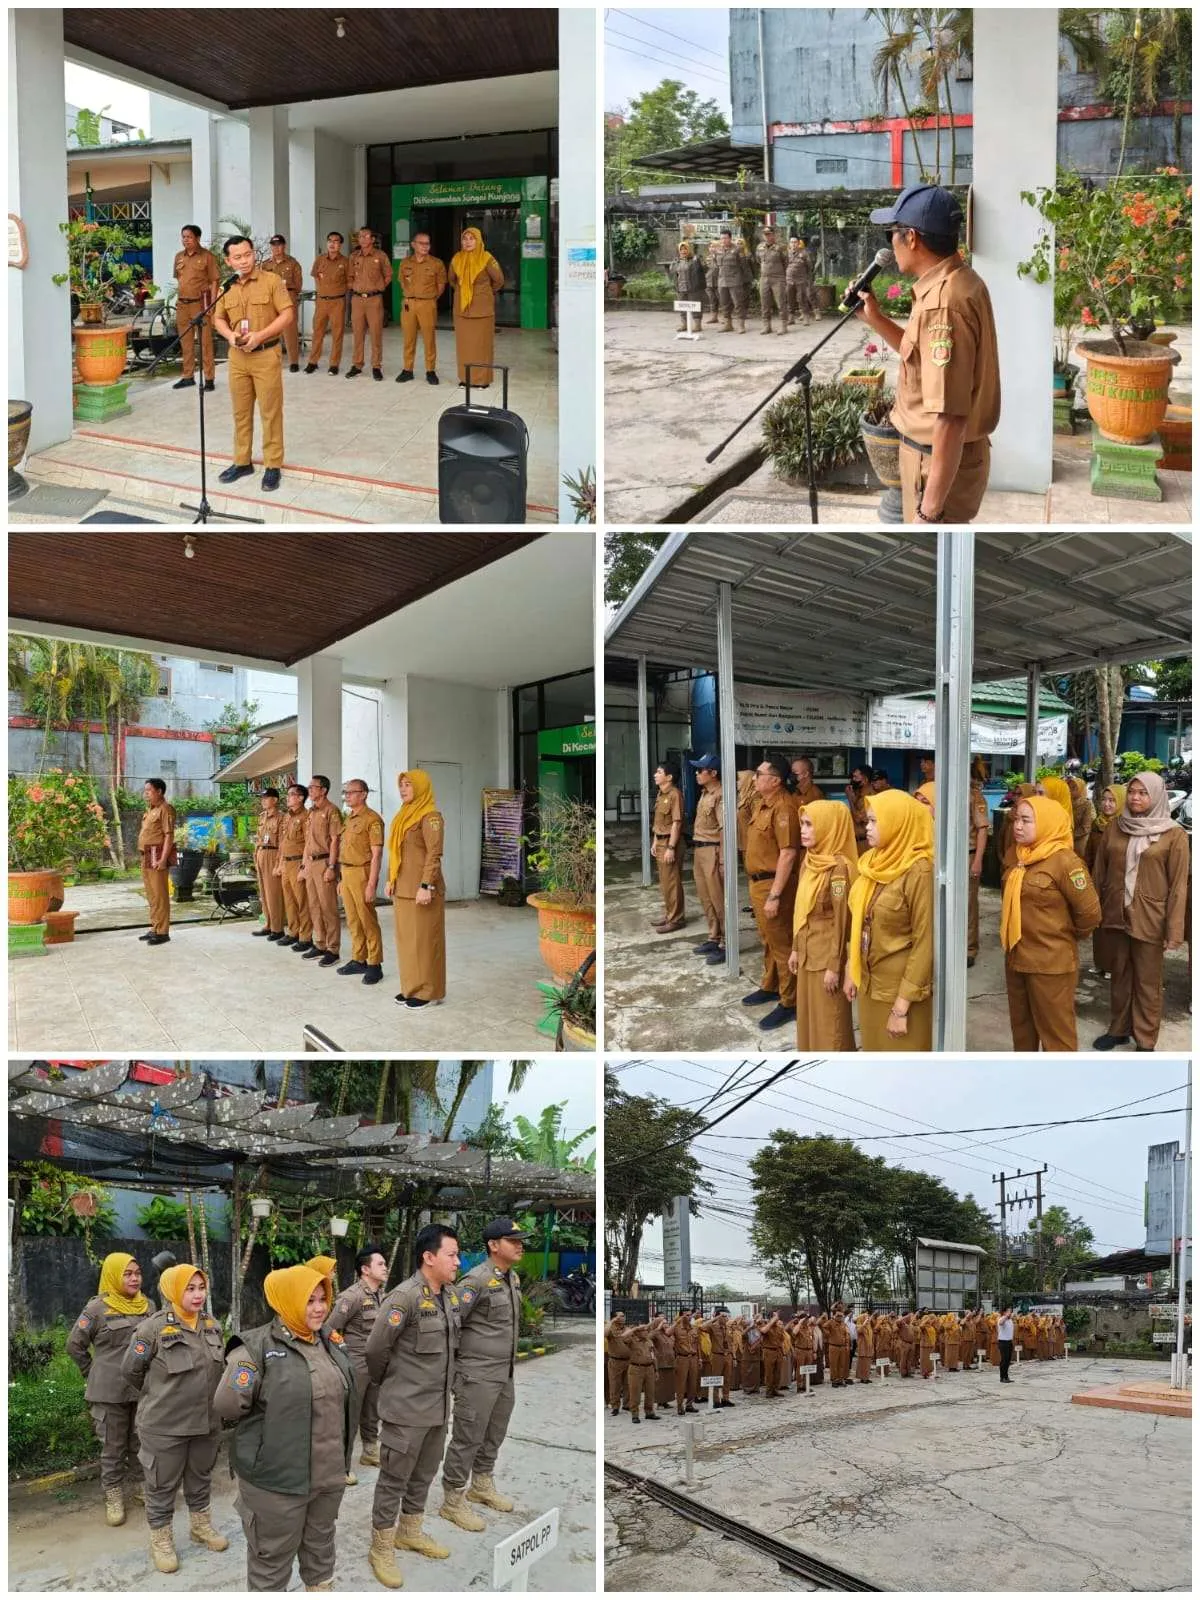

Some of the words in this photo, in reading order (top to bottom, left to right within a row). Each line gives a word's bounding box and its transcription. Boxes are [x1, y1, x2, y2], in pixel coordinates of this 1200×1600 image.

[430, 182, 464, 194] Selamat
[470, 180, 503, 193] Datang
[462, 193, 486, 204] Sungai
[487, 191, 520, 203] Kunjang
[510, 1533, 540, 1566] SATPOL
[541, 1524, 551, 1545] PP
